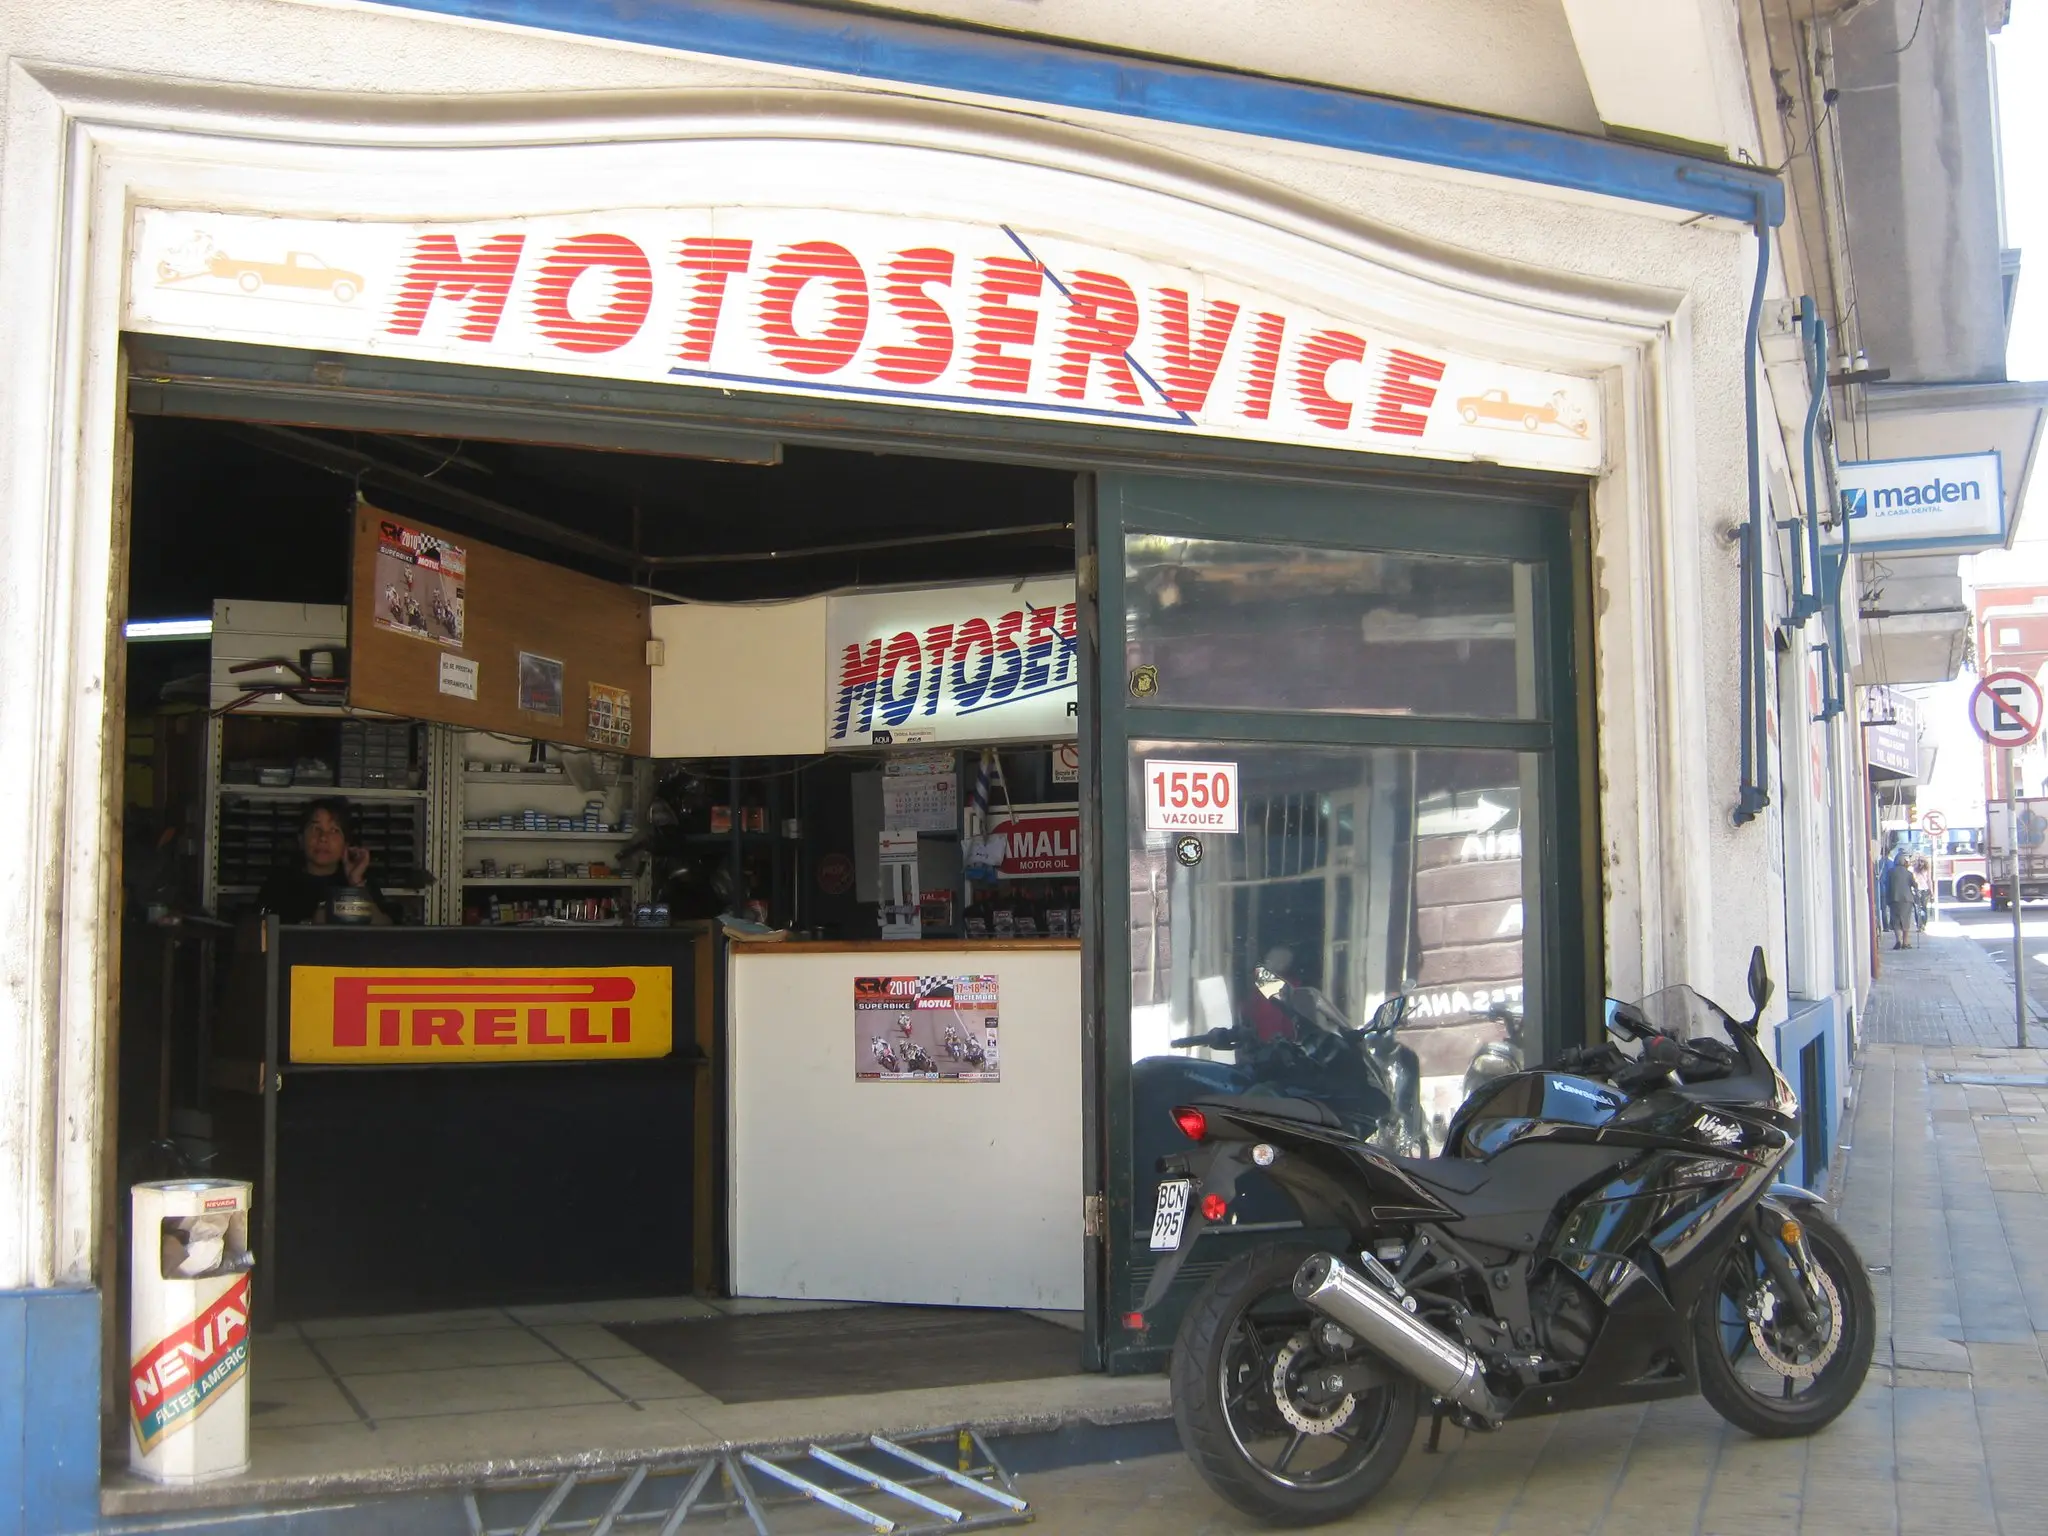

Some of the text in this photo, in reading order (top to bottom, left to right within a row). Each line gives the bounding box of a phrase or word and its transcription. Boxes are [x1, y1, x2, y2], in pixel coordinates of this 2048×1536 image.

[378, 233, 1446, 437] MOTOSERVICE
[1874, 478, 1980, 508] maden
[418, 556, 440, 570] MOTUL
[1153, 772, 1229, 808] 1550
[1162, 814, 1224, 824] VAZQUEZ
[1020, 859, 1070, 870] MOTOR OIL
[889, 981, 915, 995] 2010
[333, 977, 636, 1047] PIRELLI
[918, 999, 952, 1008] MOTUL
[1552, 1080, 1615, 1106] Kawasaki
[1694, 1113, 1743, 1143] Ninja
[206, 1199, 236, 1208] NEVADA
[1158, 1184, 1186, 1209] BCN
[1155, 1211, 1181, 1237] 995
[155, 1383, 201, 1425] FILTER
